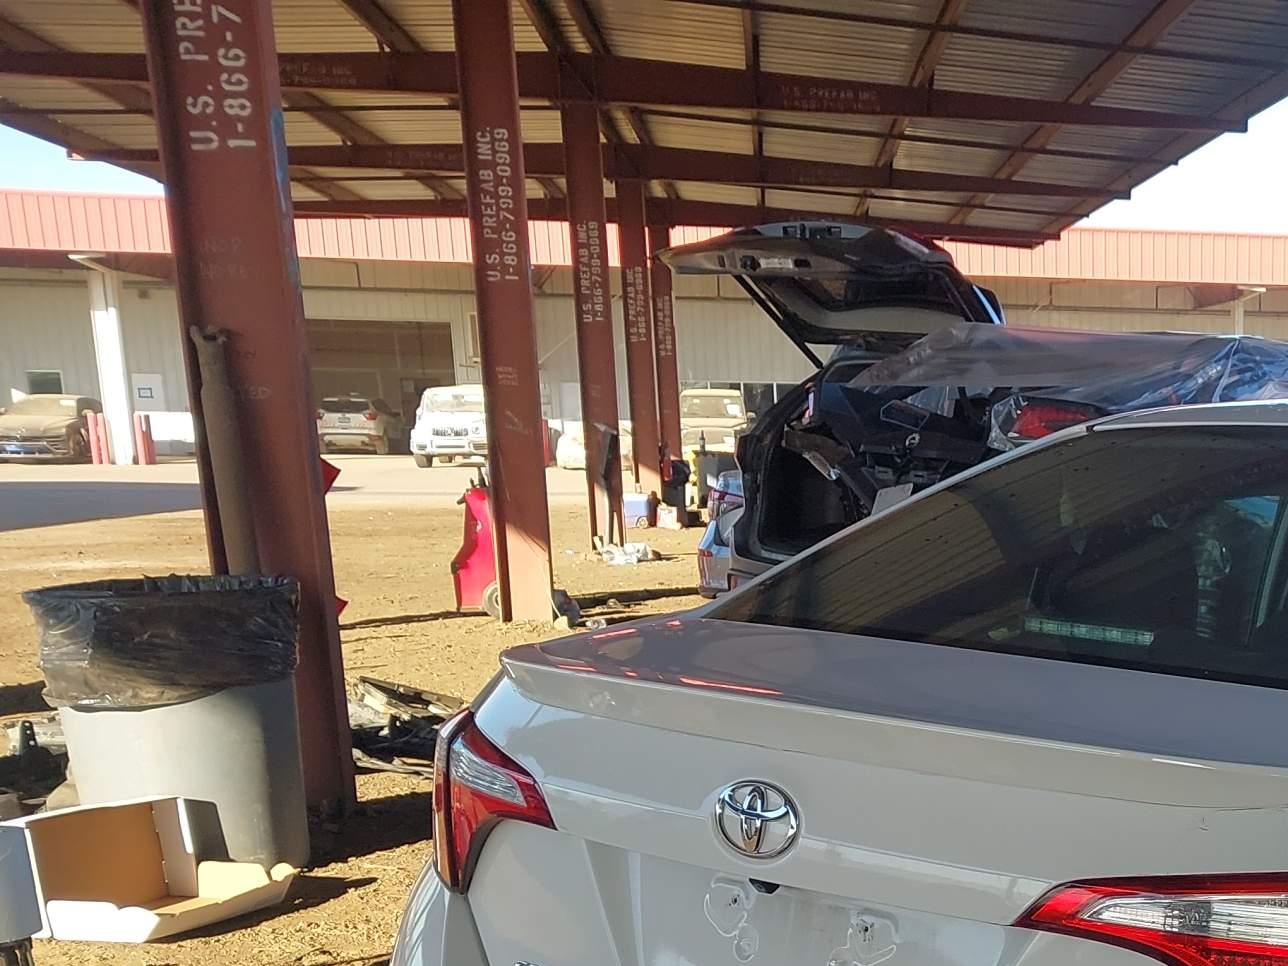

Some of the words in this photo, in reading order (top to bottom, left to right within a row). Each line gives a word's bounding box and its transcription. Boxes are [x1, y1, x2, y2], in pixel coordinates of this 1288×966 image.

[211, 4, 257, 149] 1-866-7
[186, 84, 219, 150] U.S.
[475, 127, 493, 160] INC.
[479, 169, 499, 239] PREFAB
[494, 128, 519, 280] 1-866-799-0969
[486, 249, 502, 282] U.S.
[578, 249, 591, 294] PREFAB
